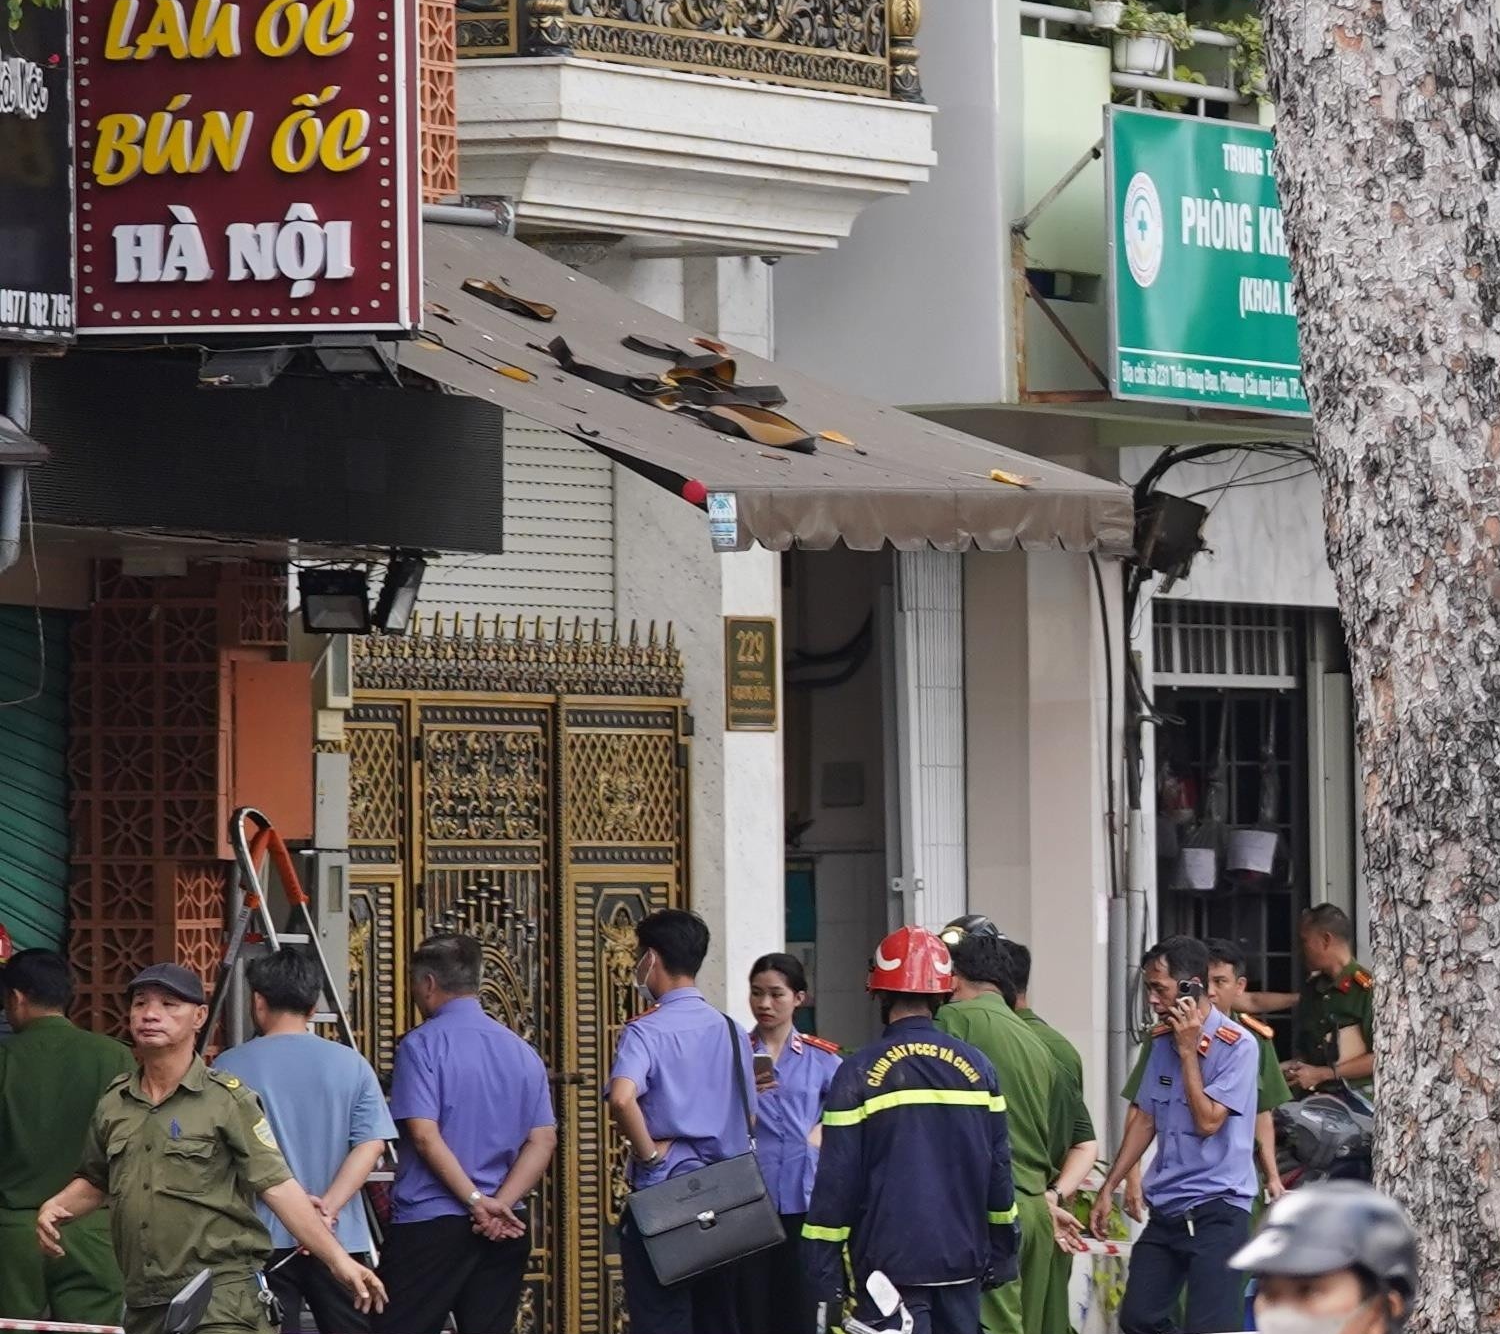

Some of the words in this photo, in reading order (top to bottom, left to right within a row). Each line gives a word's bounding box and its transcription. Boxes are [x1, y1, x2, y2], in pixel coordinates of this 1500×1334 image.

[92, 93, 254, 186] BÚN
[271, 84, 371, 174] ỐC
[1222, 143, 1264, 176] TRUNG
[112, 203, 215, 284] HÀ
[225, 201, 356, 300] NỘI
[1181, 187, 1253, 253] PHÒNG
[735, 629, 766, 664] 229
